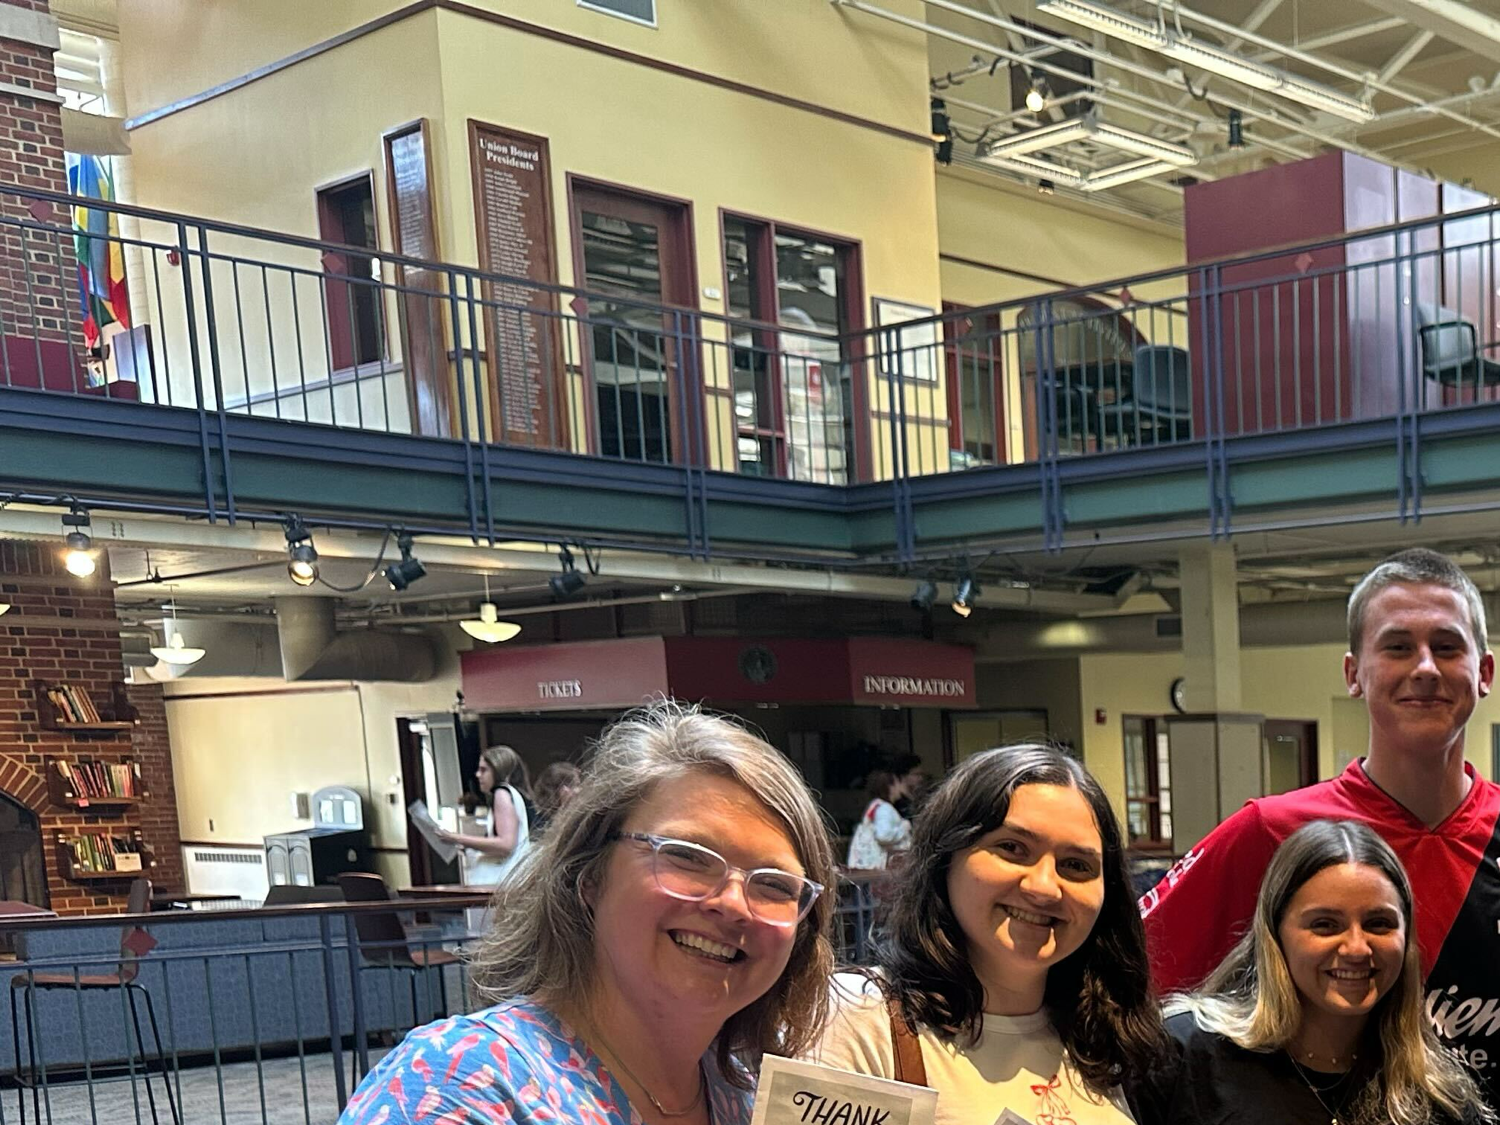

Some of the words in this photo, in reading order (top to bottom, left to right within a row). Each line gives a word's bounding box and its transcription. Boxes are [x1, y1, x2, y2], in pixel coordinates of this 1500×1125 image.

[480, 138, 508, 154] Union
[510, 145, 539, 162] Board
[486, 151, 535, 171] Presidents
[538, 680, 582, 698] TICKETS
[864, 676, 965, 696] INFORMATION
